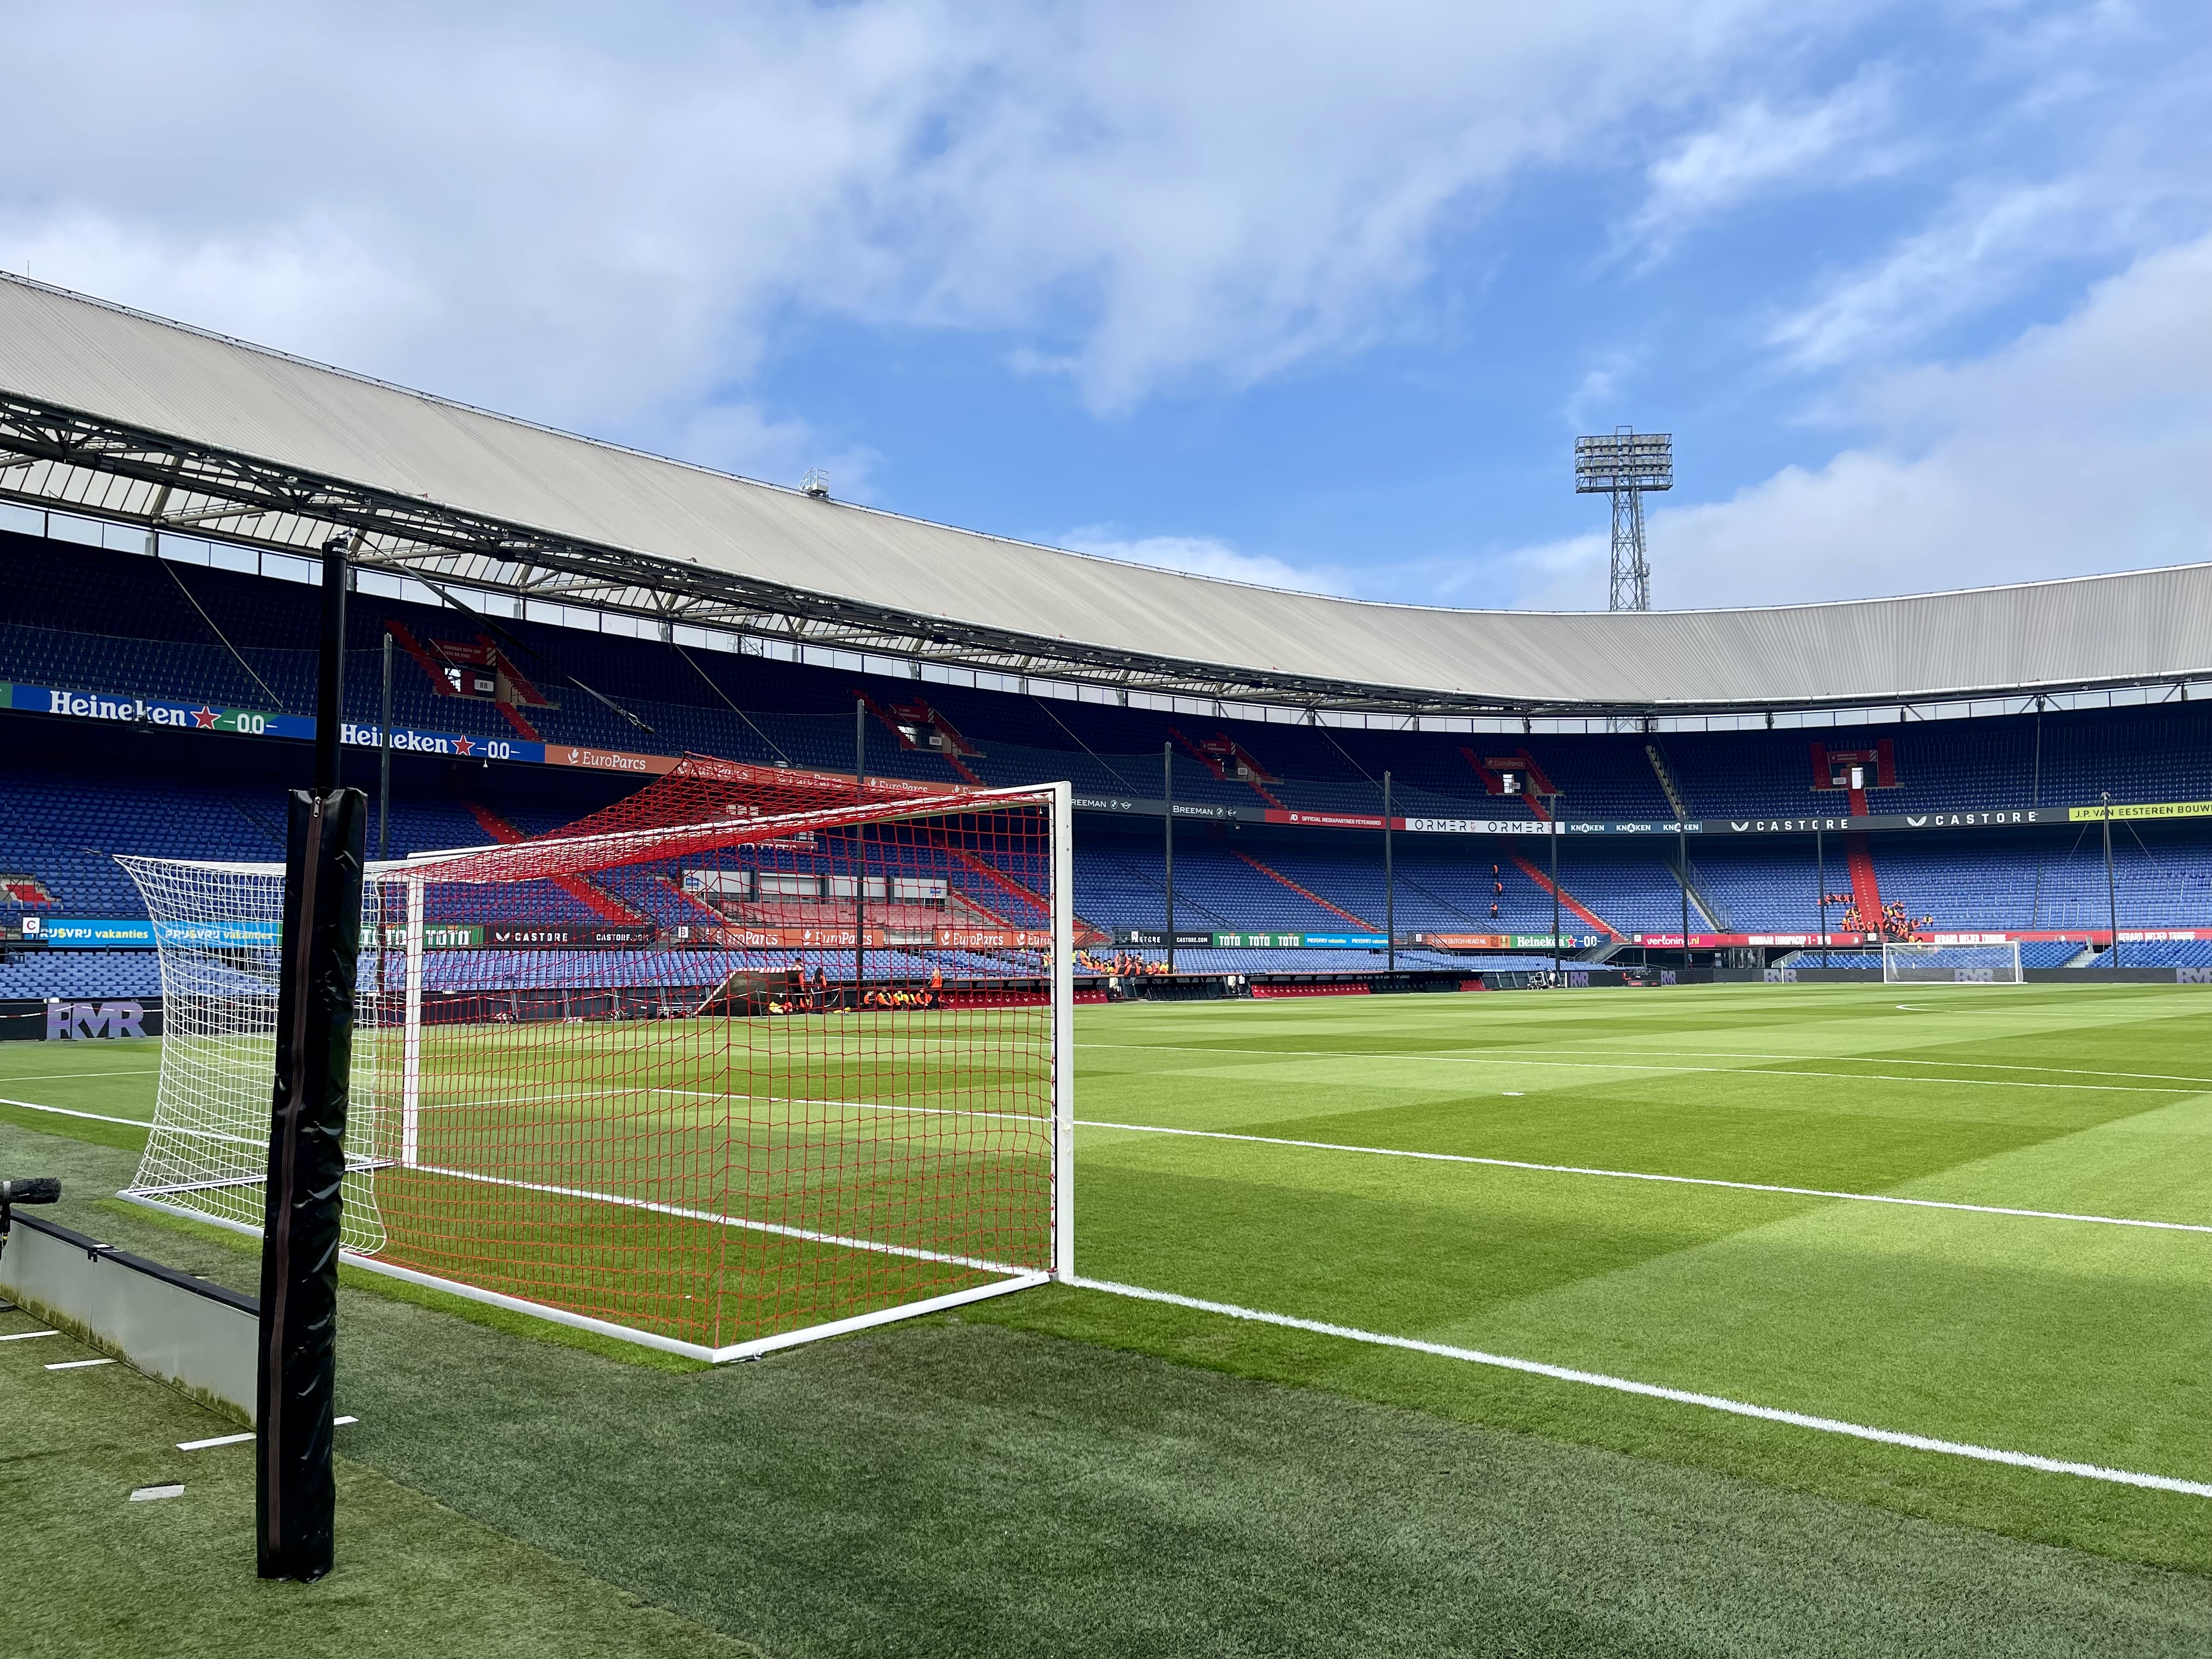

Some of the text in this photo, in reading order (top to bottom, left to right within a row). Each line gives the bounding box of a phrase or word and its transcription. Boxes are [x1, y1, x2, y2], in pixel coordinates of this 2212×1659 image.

[49, 690, 187, 726] Heineken
[582, 751, 646, 770] EuroParcs
[1071, 799, 1107, 808] REEMAN
[1173, 805, 1214, 815] BREEMAN
[2094, 809, 2114, 817] VAN
[2119, 806, 2174, 816] EESTEREN
[2177, 804, 2212, 814] BOUW
[1936, 811, 2036, 826] CASTORE
[1415, 820, 1466, 831] ORMER
[1488, 822, 1544, 833] ORMER
[1571, 824, 1605, 832] KNAKEN
[1616, 824, 1651, 832] KNAKEN
[1757, 819, 1848, 831] CASTORE
[27, 920, 36, 930] C
[31, 928, 149, 939] RIJSVRIJ vakanties
[426, 930, 470, 945] TOTO
[515, 933, 568, 942] CASTORE
[815, 932, 872, 945] EuroPacs
[952, 933, 1003, 946] EuroParcs
[1218, 936, 1299, 946] TOTO TOTO TOTO
[1517, 936, 1565, 947] Heineken
[1748, 936, 1774, 945] WINNAAR
[1775, 935, 1807, 945] EUROPACUP
